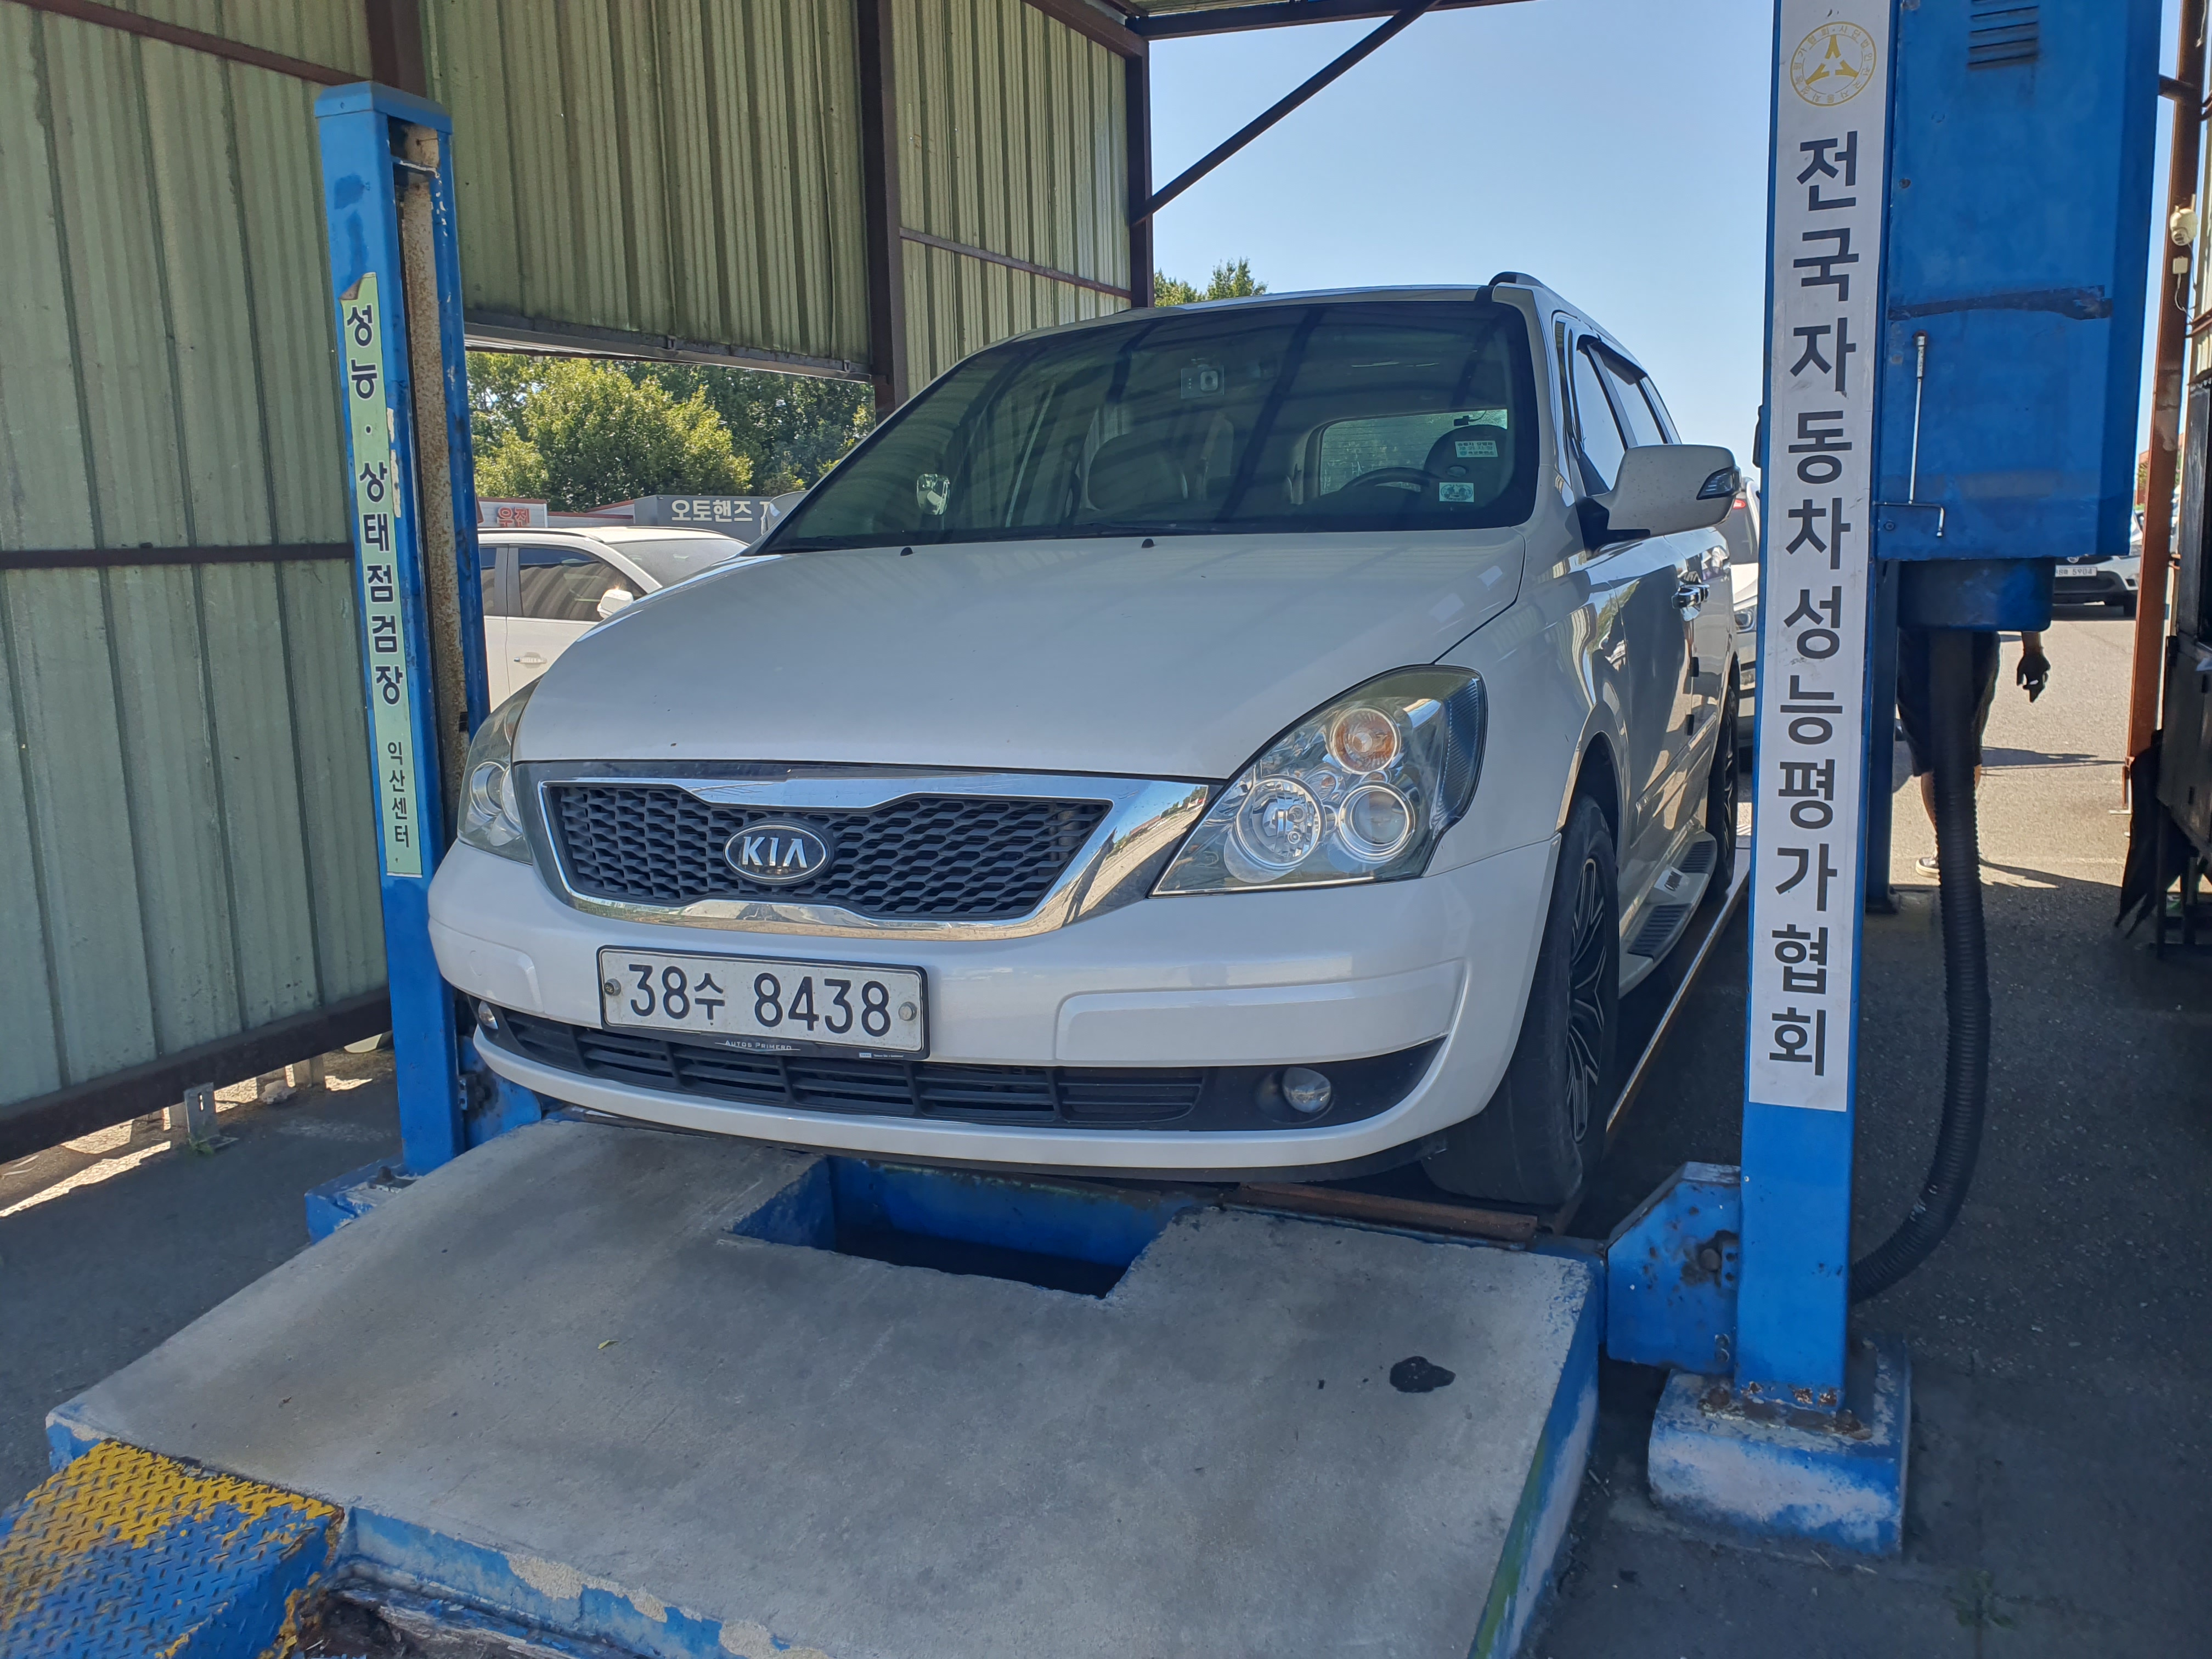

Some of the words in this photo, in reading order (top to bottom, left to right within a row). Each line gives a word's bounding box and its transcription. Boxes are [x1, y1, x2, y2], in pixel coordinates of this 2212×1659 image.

[1769, 130, 1859, 1077] 전국자동차성능평가협회
[387, 741, 410, 848] 익산센터
[742, 836, 808, 868] KIA
[629, 963, 725, 1021] 38수
[754, 972, 891, 1037] 8438
